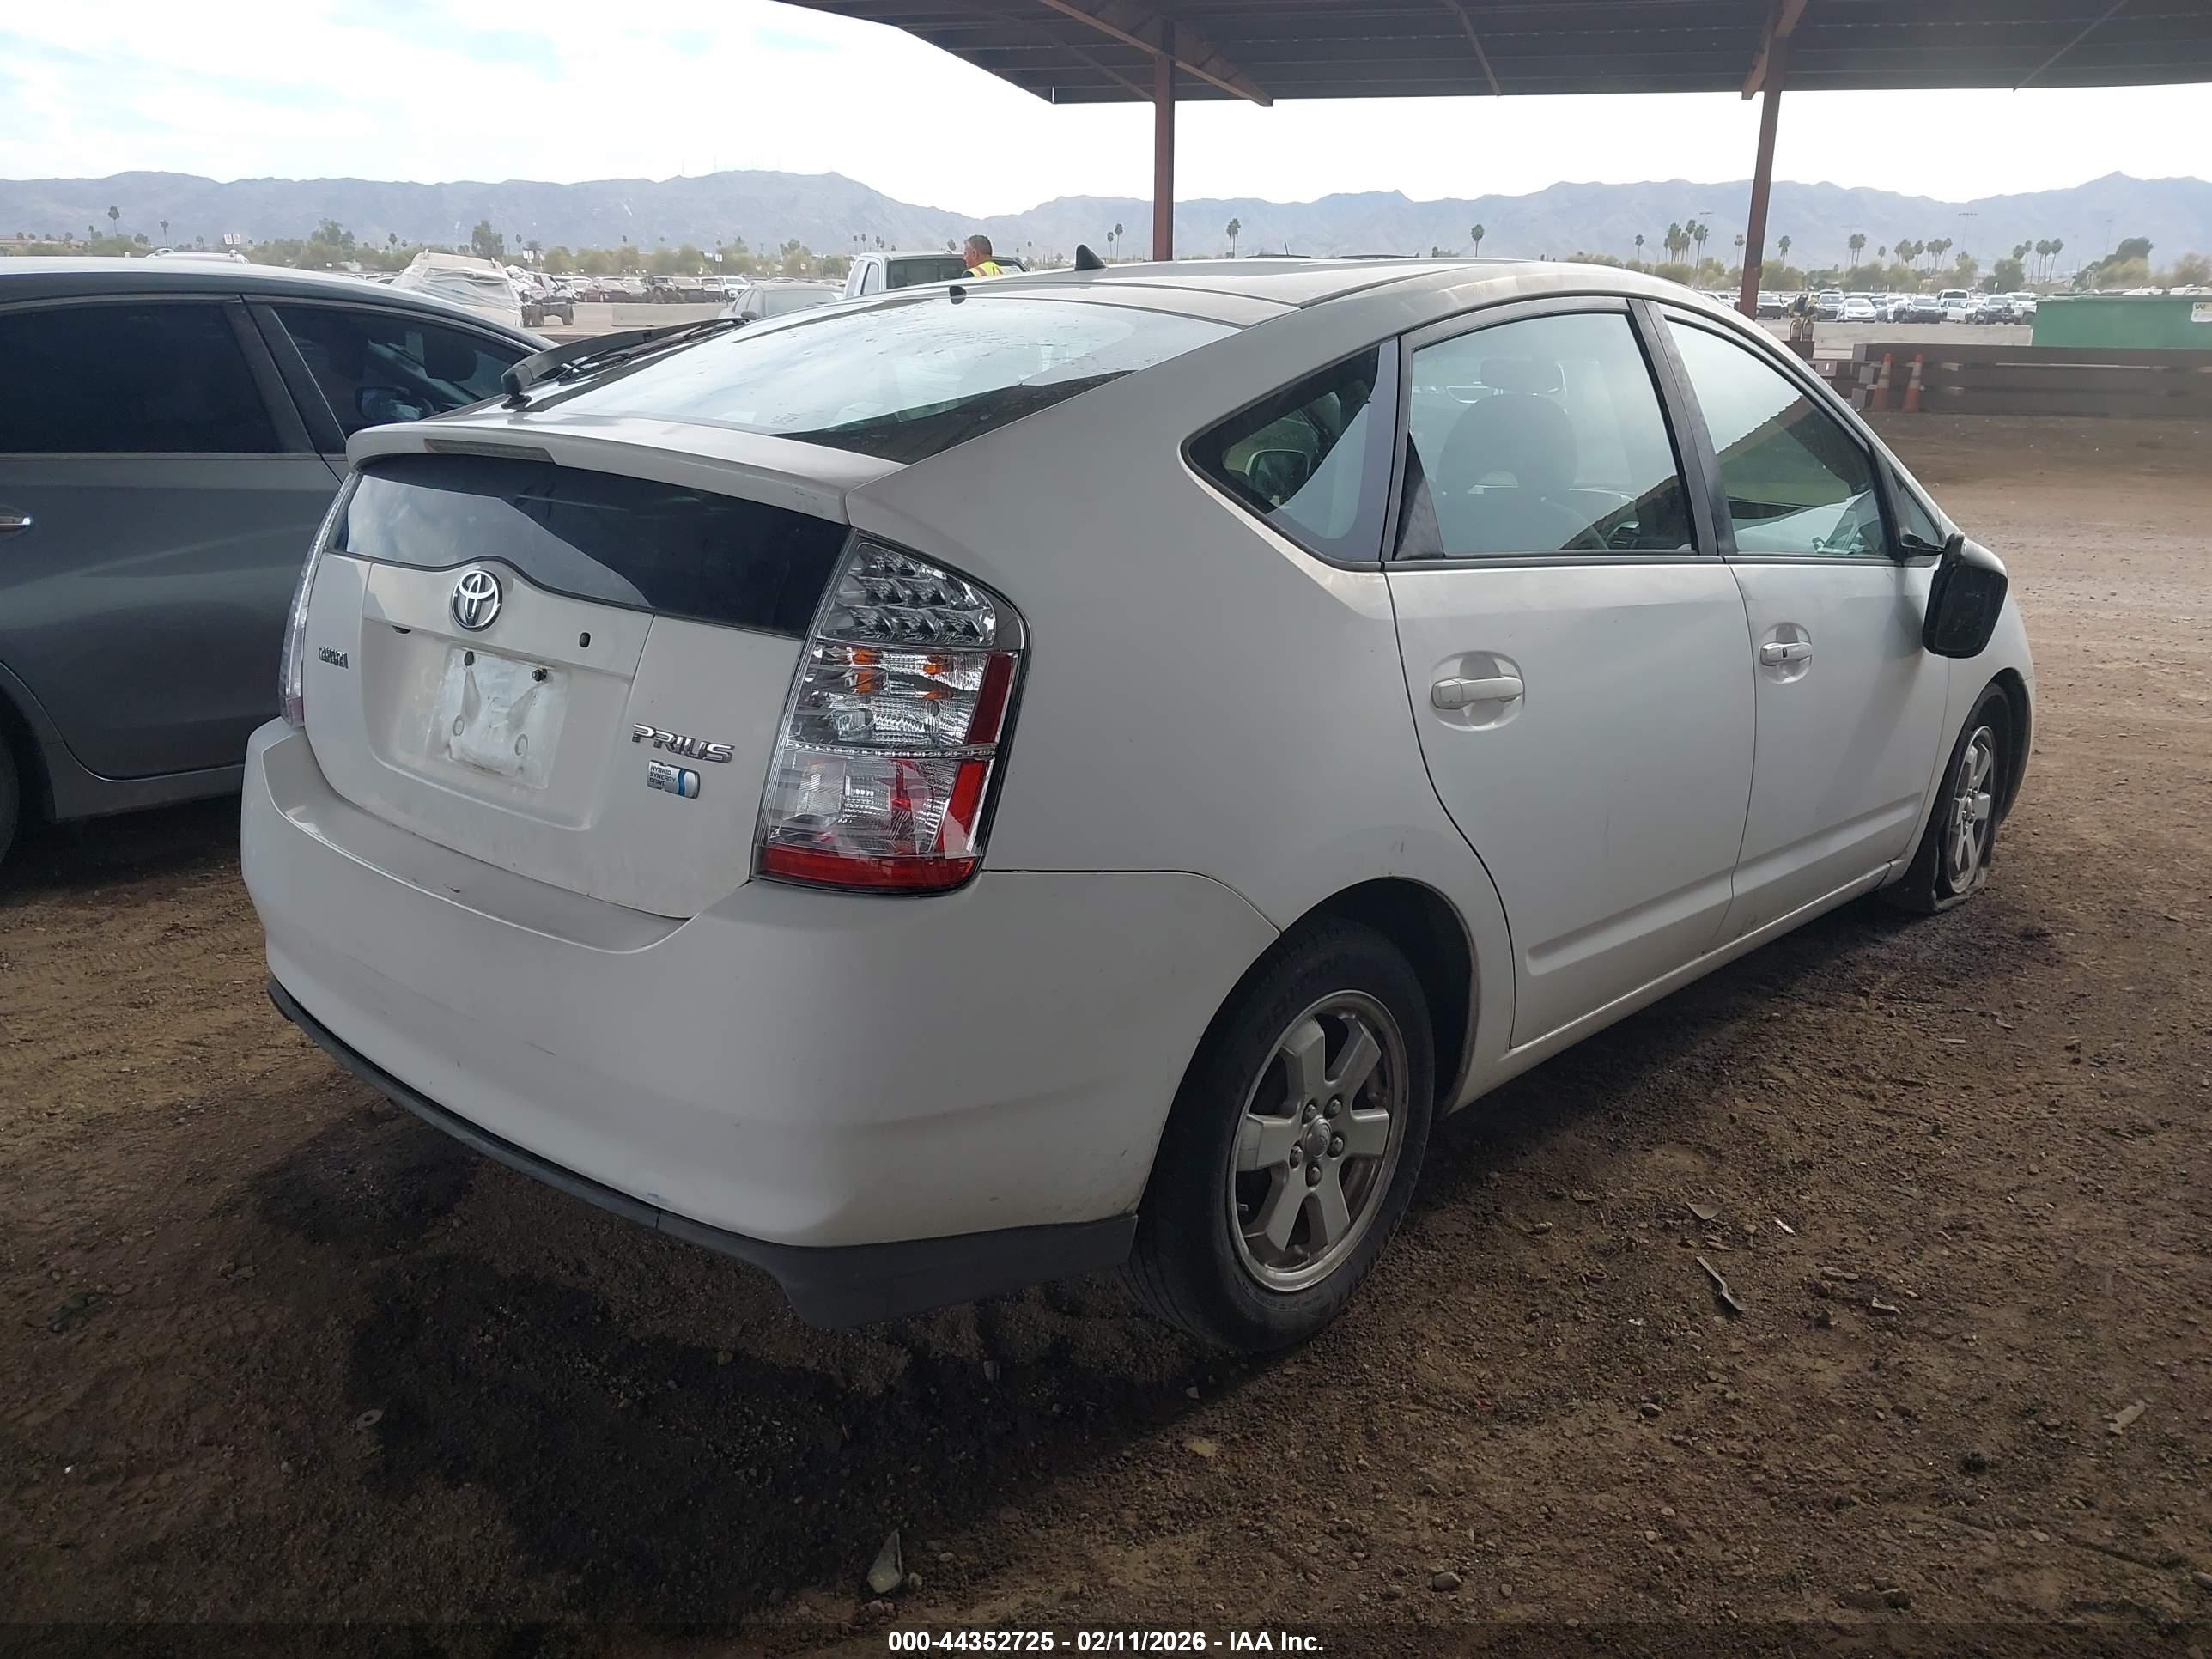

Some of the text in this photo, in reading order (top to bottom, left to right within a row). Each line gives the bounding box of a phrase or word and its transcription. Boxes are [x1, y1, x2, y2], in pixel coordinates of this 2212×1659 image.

[631, 723, 736, 763] PRIUS
[650, 765, 672, 776] HYBRID
[649, 771, 677, 783] SYNERGY
